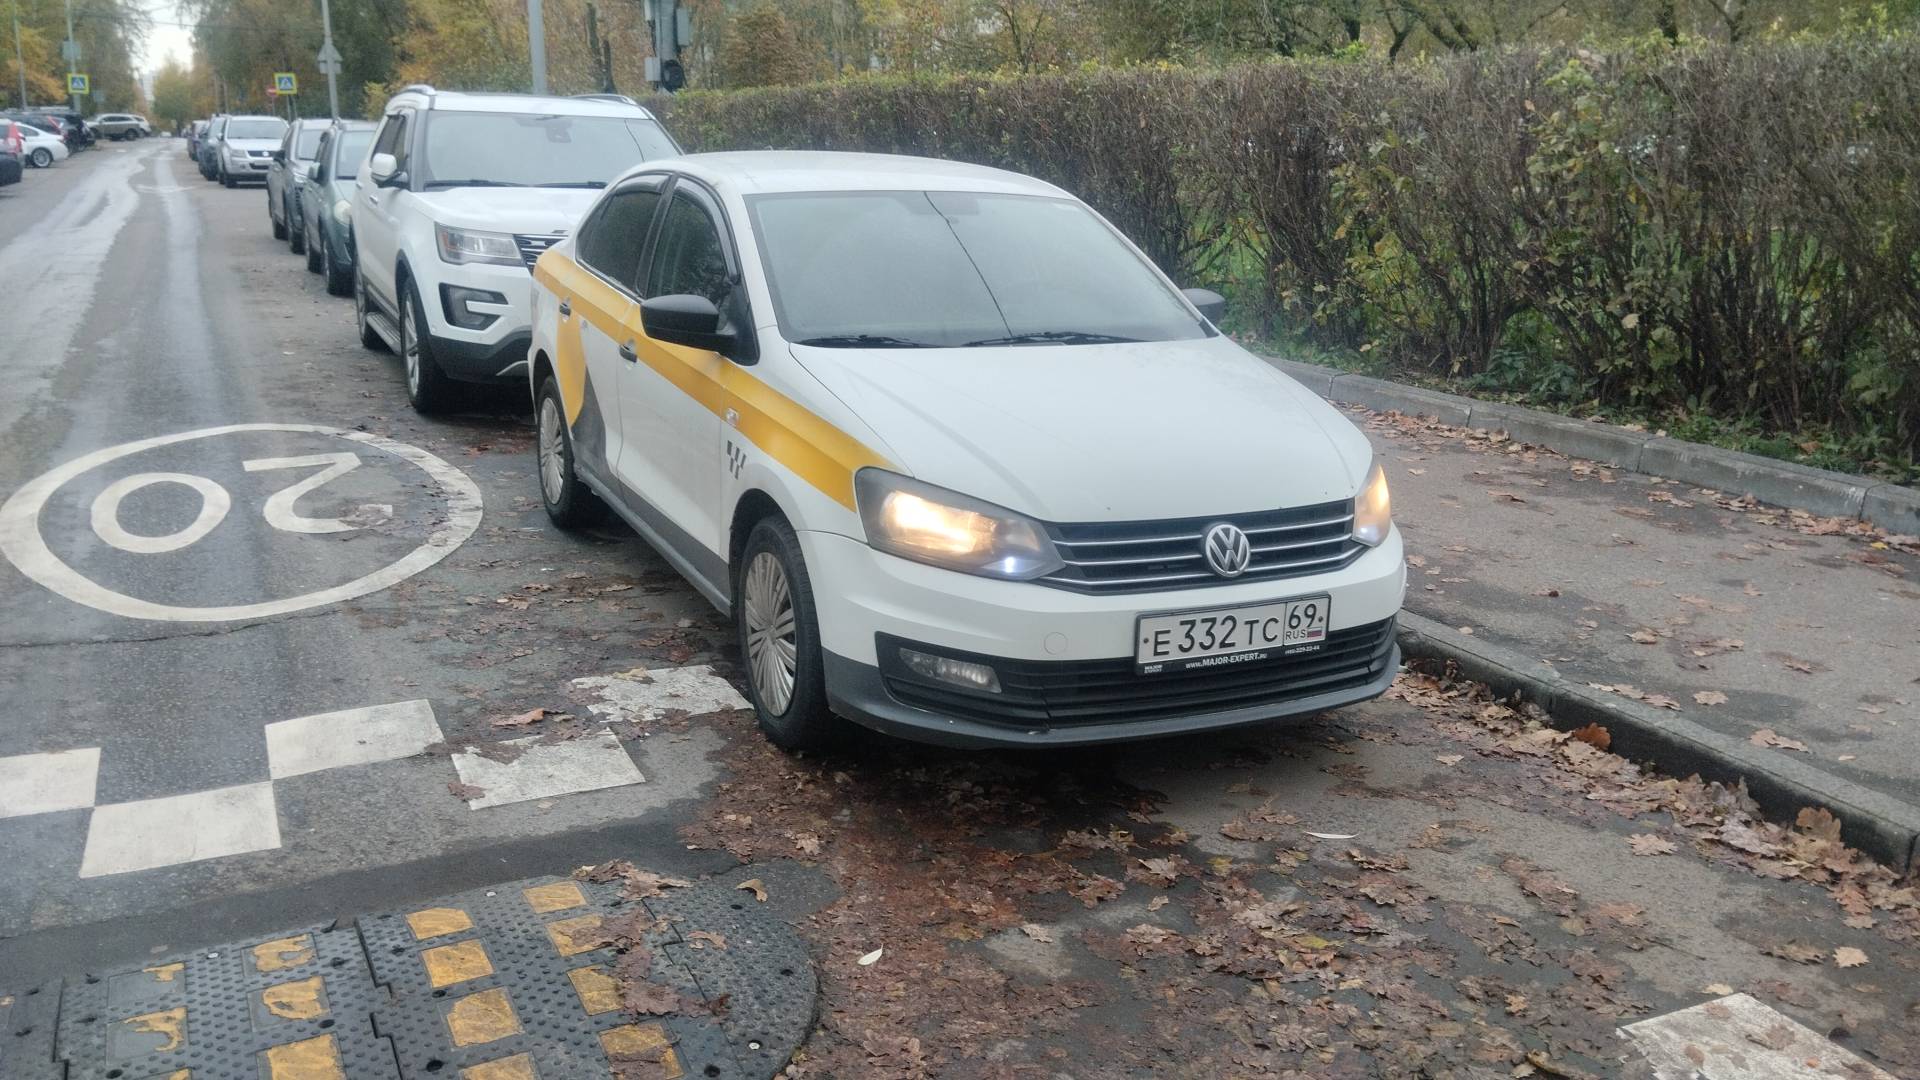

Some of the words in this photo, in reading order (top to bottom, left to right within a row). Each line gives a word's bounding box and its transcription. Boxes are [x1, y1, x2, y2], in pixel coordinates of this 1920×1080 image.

[91, 452, 394, 553] 20
[1288, 603, 1317, 629] 69
[1285, 629, 1306, 640] RUS
